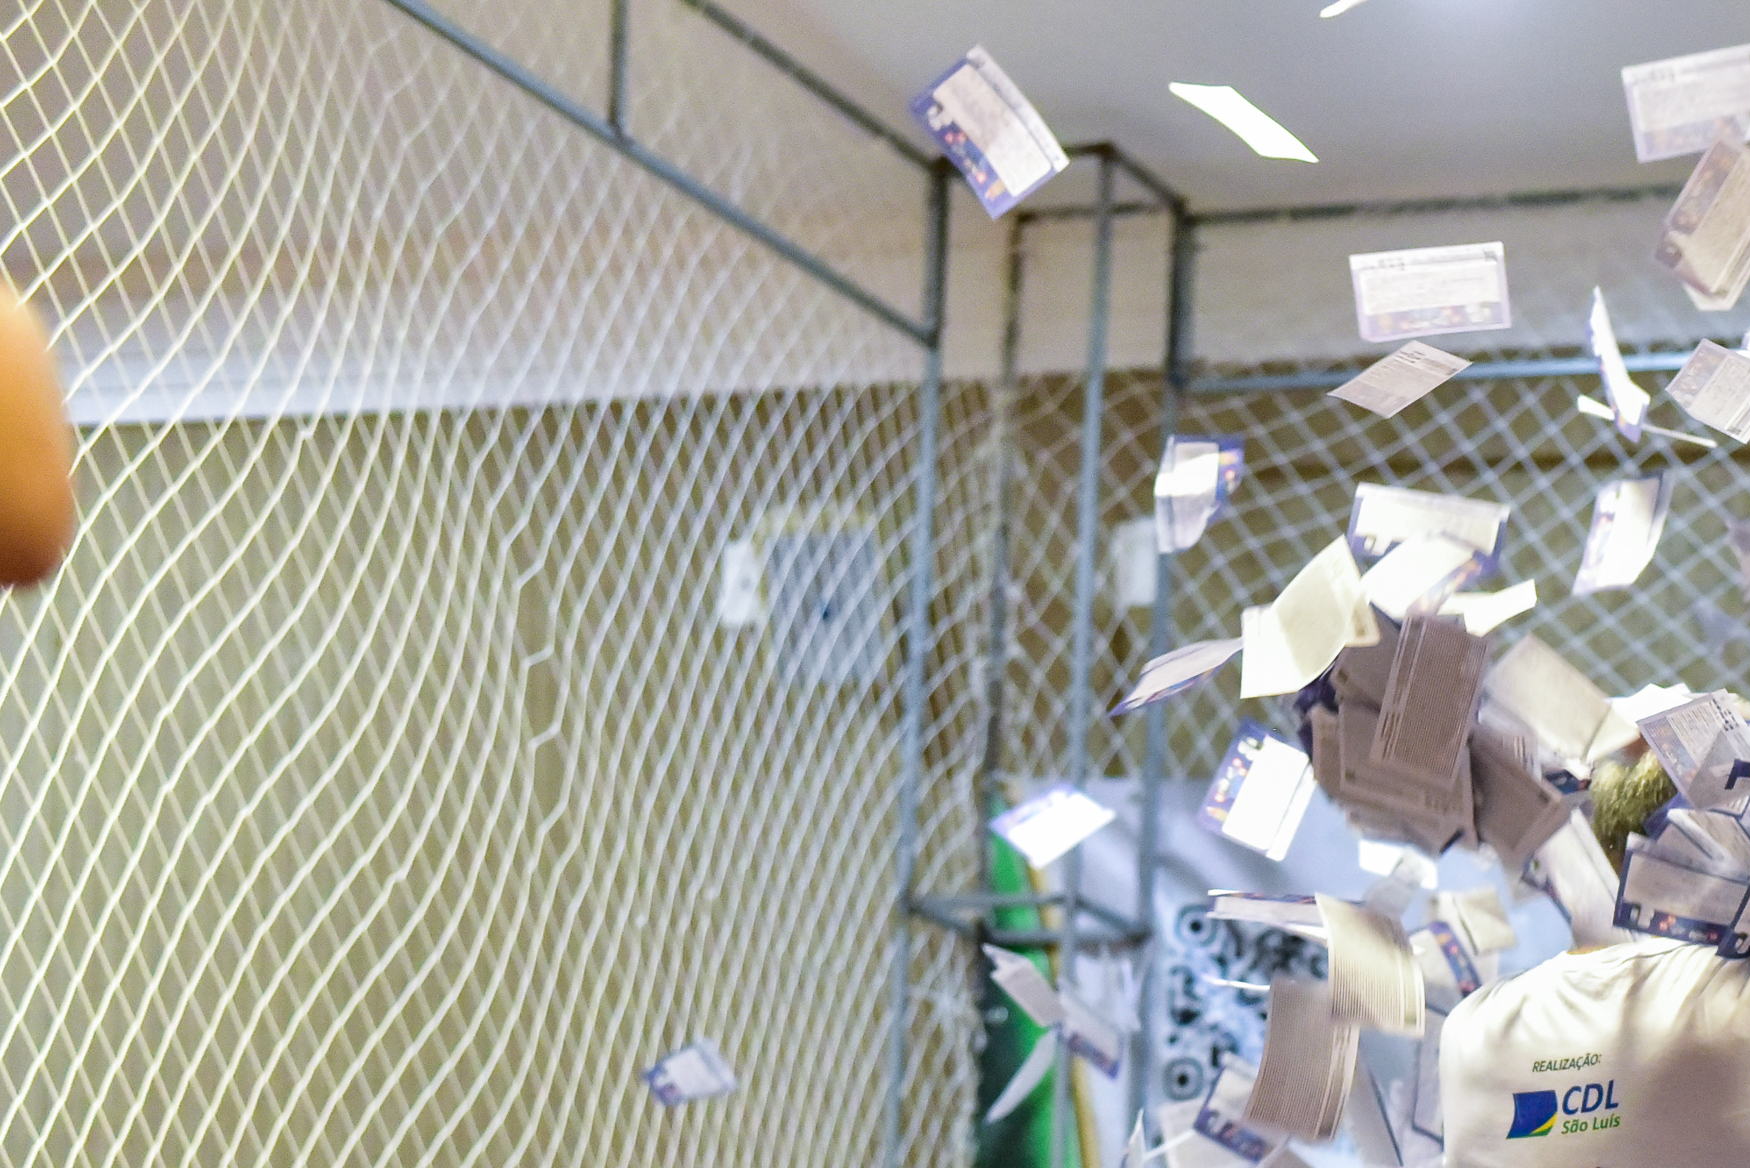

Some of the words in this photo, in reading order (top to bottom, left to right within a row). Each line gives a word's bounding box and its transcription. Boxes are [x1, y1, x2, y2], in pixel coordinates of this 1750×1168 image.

[1532, 1053, 1601, 1073] REALIZAÇÃO:
[1562, 1079, 1619, 1116] CDL
[1561, 1118, 1588, 1135] São
[1592, 1113, 1621, 1130] Luís
